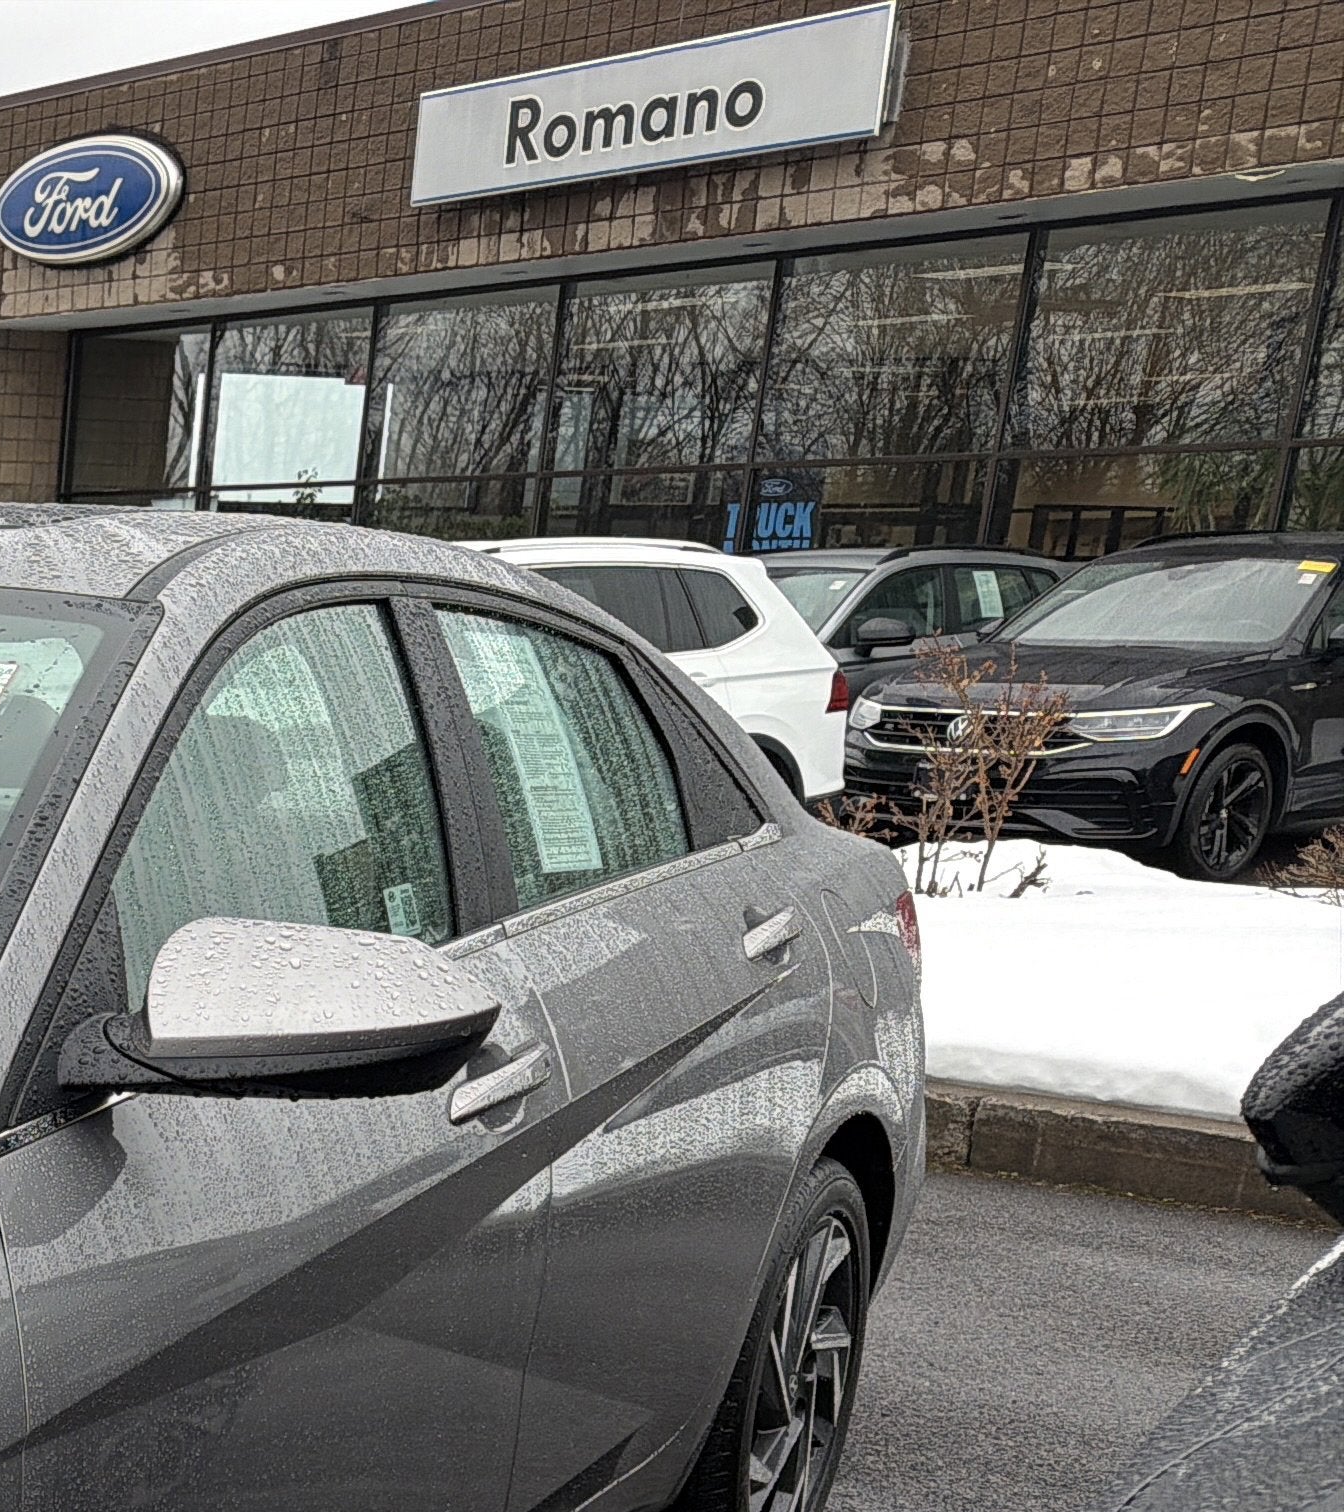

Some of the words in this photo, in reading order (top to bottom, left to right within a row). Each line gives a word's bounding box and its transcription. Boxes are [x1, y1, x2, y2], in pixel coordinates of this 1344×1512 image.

[503, 79, 766, 167] Romano
[24, 167, 124, 238] Ford
[760, 481, 787, 494] Ford
[726, 501, 816, 538] TUCK
